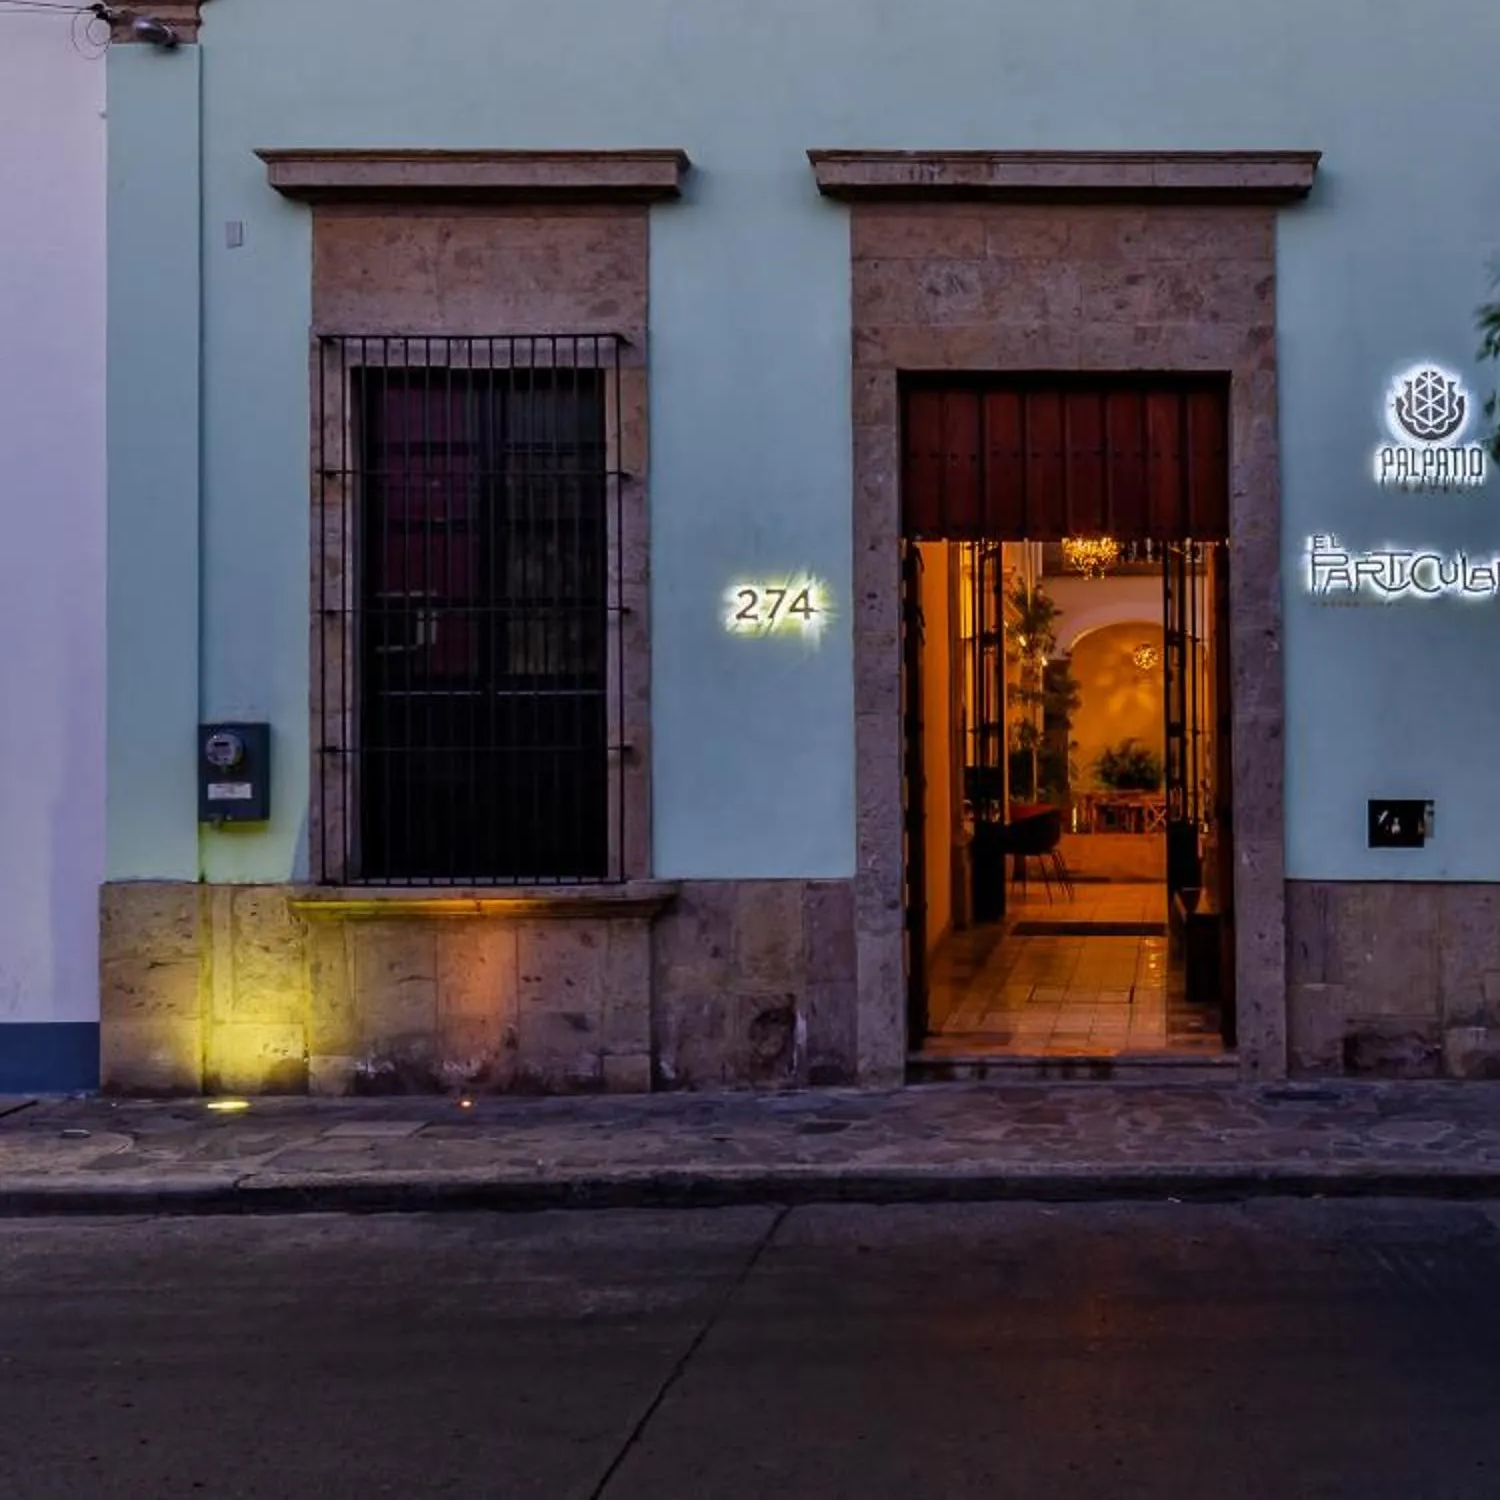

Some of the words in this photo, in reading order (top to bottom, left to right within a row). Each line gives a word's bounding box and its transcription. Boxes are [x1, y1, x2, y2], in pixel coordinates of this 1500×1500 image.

[1381, 447, 1483, 478] PALPATIO
[1313, 534, 1341, 549] EL
[735, 588, 820, 620] 274
